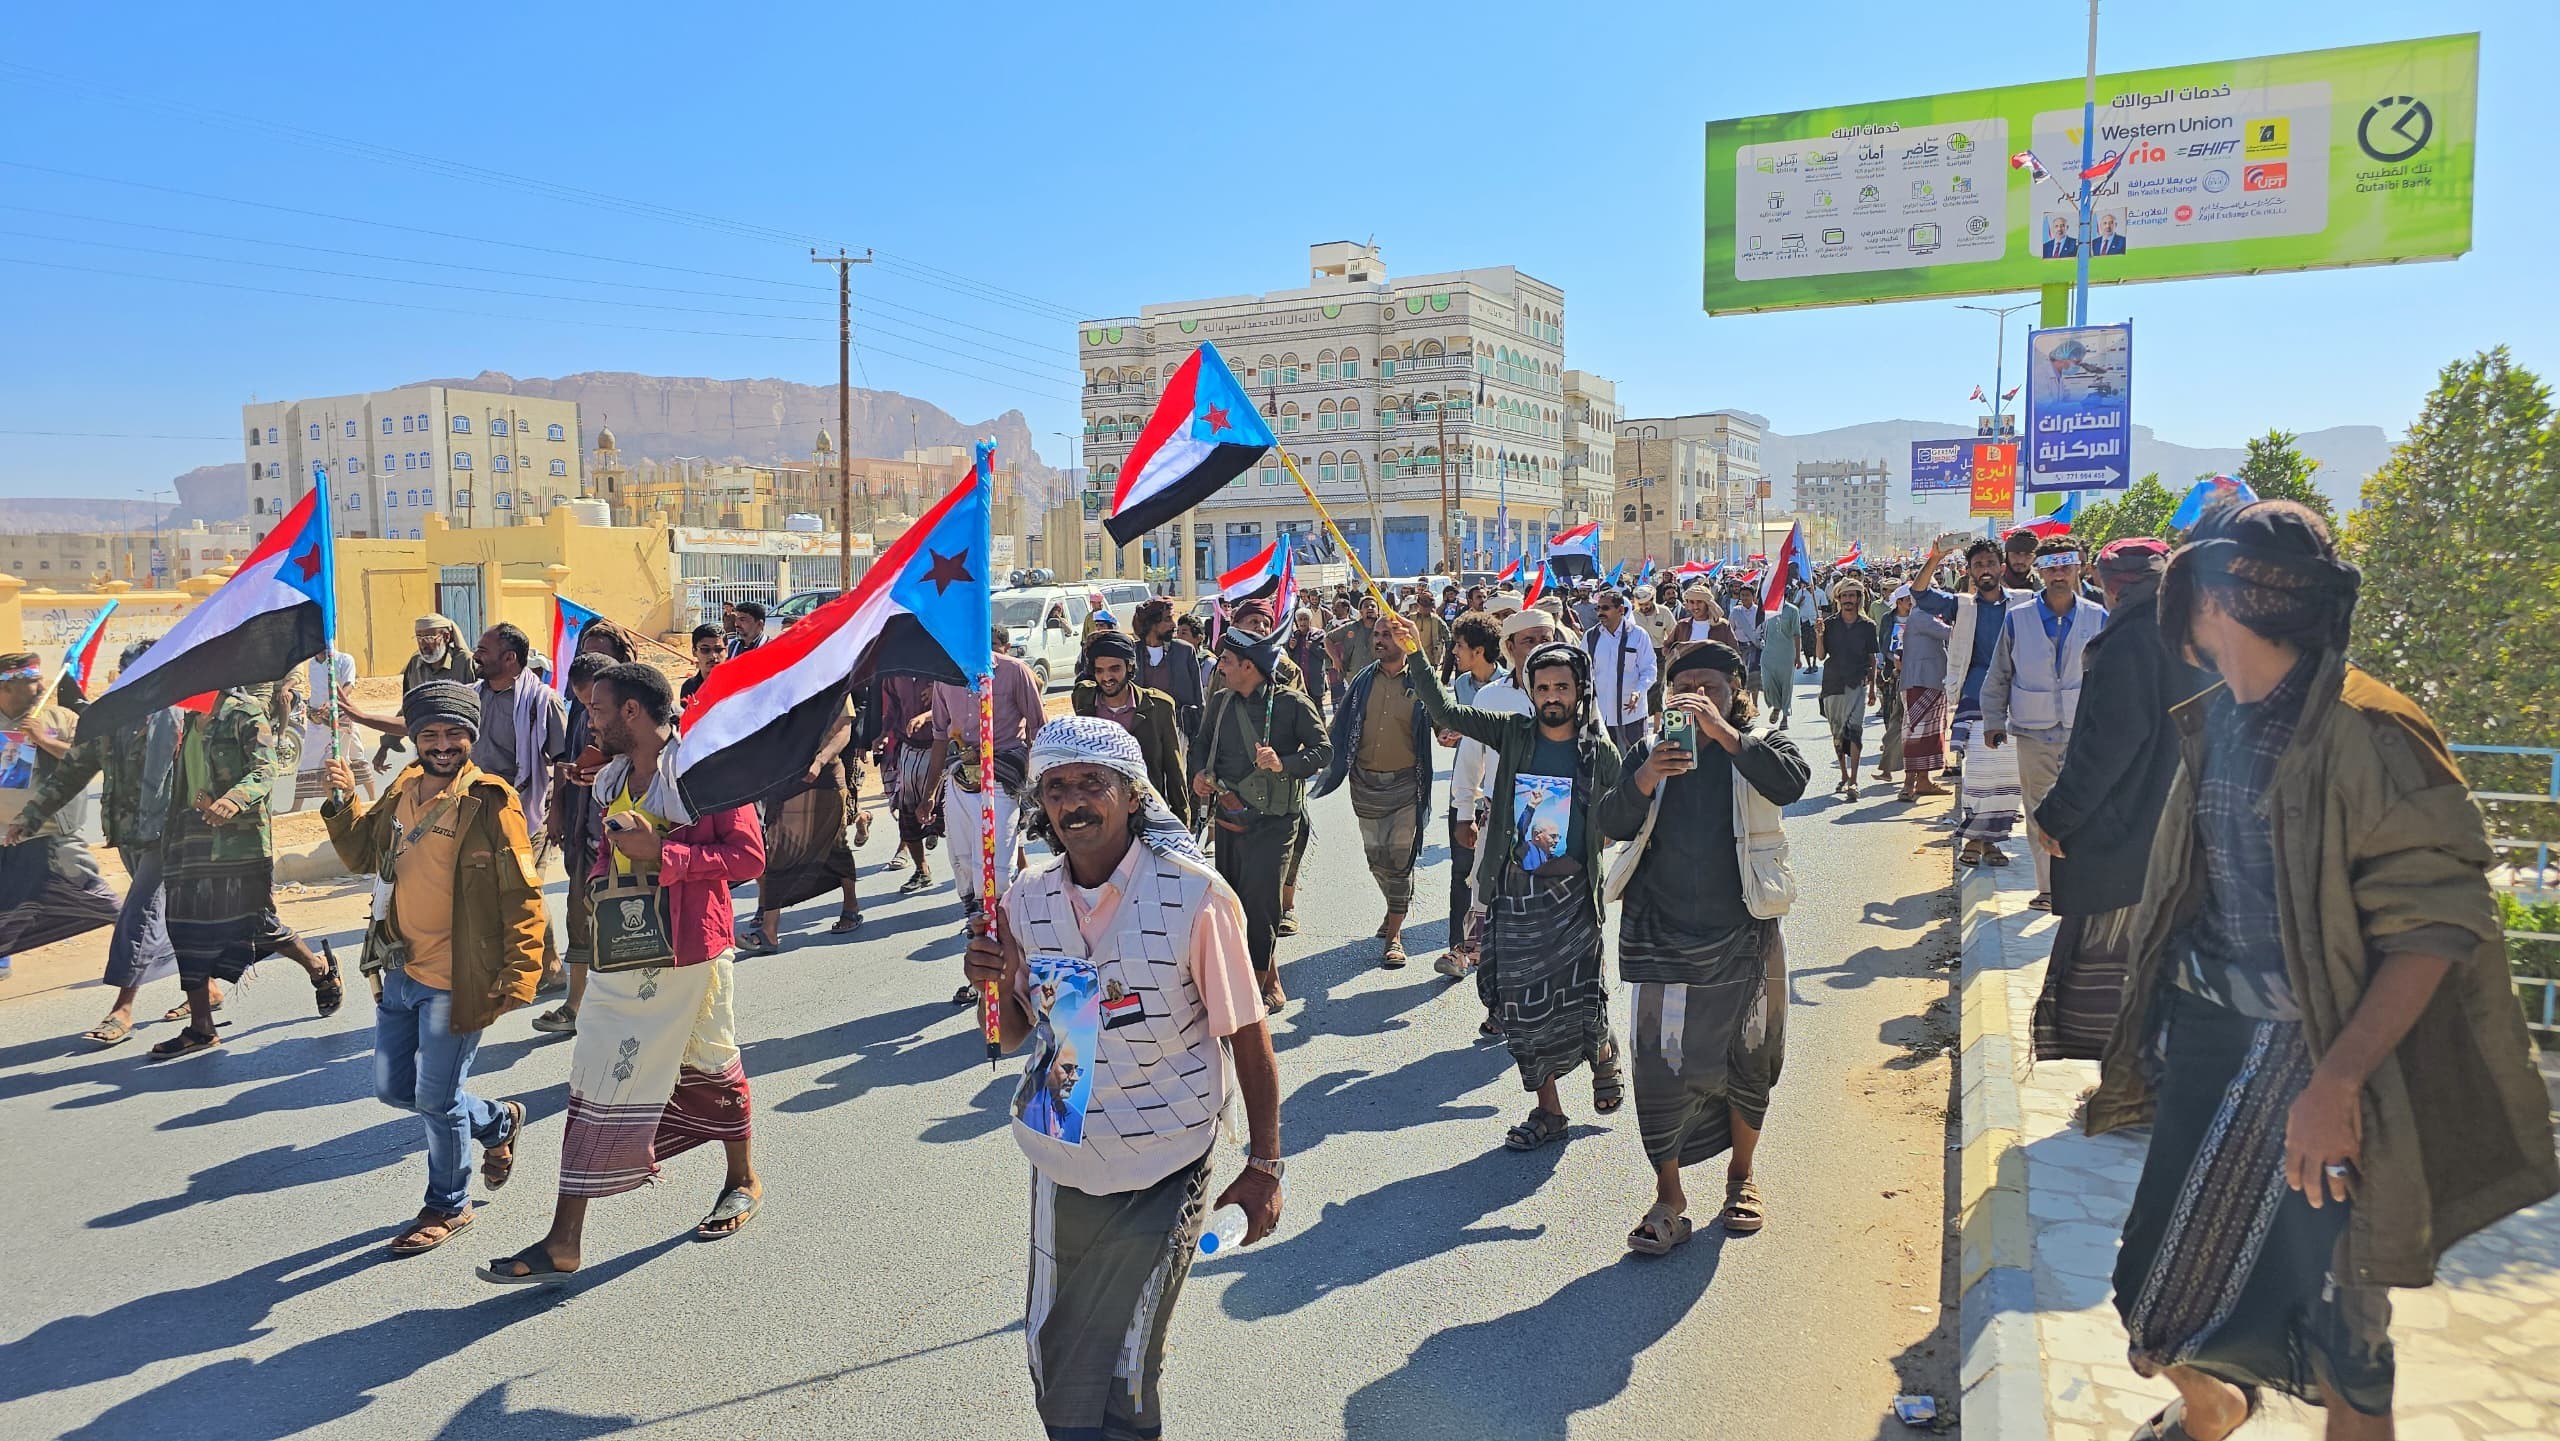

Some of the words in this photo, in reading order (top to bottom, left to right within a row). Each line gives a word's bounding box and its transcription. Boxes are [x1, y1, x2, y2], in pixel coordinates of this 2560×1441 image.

[2112, 89, 2174, 109] الحوالات
[2179, 83, 2231, 101] خدمات
[1831, 126, 1860, 141] البنك
[1863, 122, 1900, 136] خدمات
[2101, 122, 2176, 141] Western
[2180, 116, 2233, 133] Union
[2128, 141, 2166, 165] ria
[2187, 139, 2240, 158] SHIFT
[2411, 164, 2432, 174] بنك
[2257, 175, 2285, 190] UPT
[2356, 180, 2400, 193] Qutaibi
[2402, 177, 2431, 188] Bank
[2038, 410, 2121, 434] المختبرات
[2039, 438, 2120, 462] المركزية
[1975, 463, 2013, 482] البرج
[1974, 486, 2012, 504] ماركت
